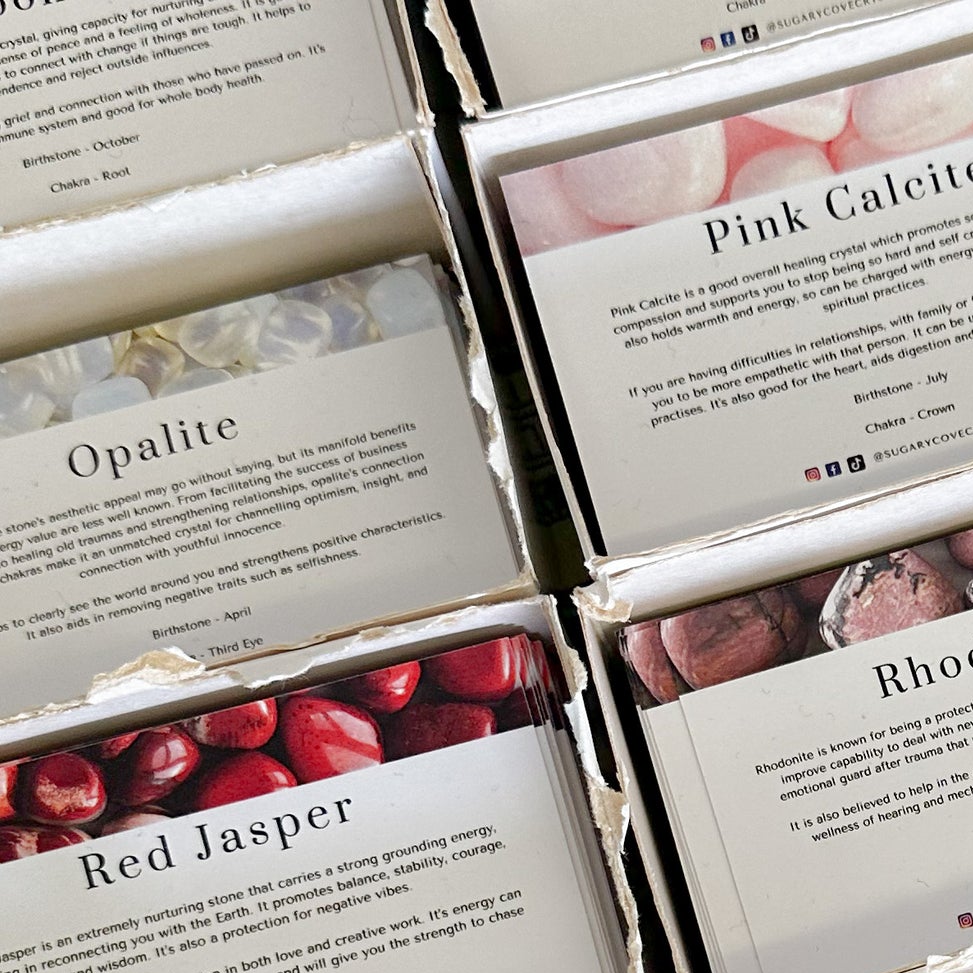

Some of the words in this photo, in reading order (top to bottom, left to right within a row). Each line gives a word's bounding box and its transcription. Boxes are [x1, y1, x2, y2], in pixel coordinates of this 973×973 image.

[3, 111, 30, 128] grief
[34, 105, 55, 119] and
[58, 91, 122, 113] connection
[124, 83, 150, 96] with
[152, 77, 184, 90] those
[186, 71, 211, 83] who
[213, 64, 240, 77] have
[244, 52, 283, 72] passed
[286, 50, 305, 60] on.
[308, 43, 325, 55] It's
[22, 148, 81, 169] Birthstone
[92, 134, 139, 151] October
[702, 200, 809, 254] Pink
[822, 290, 869, 313] spiritual
[872, 278, 928, 301] practices.
[853, 381, 913, 404] Birthstone
[925, 371, 948, 385] July
[67, 418, 238, 480] Opalite
[78, 556, 143, 578] connection
[144, 547, 171, 561] with
[172, 533, 220, 557] youthful
[223, 520, 285, 541] innocence.
[151, 618, 211, 640] Birthstone
[224, 606, 251, 622] April
[77, 834, 176, 890] Red
[194, 798, 351, 860] Jasper
[96, 953, 153, 973] wisdom.
[155, 944, 175, 957] It's
[179, 937, 206, 952] also
[210, 934, 218, 943] a
[221, 915, 290, 943] protection
[293, 908, 312, 921] for
[316, 893, 371, 915] negative
[374, 883, 412, 899] vibes.
